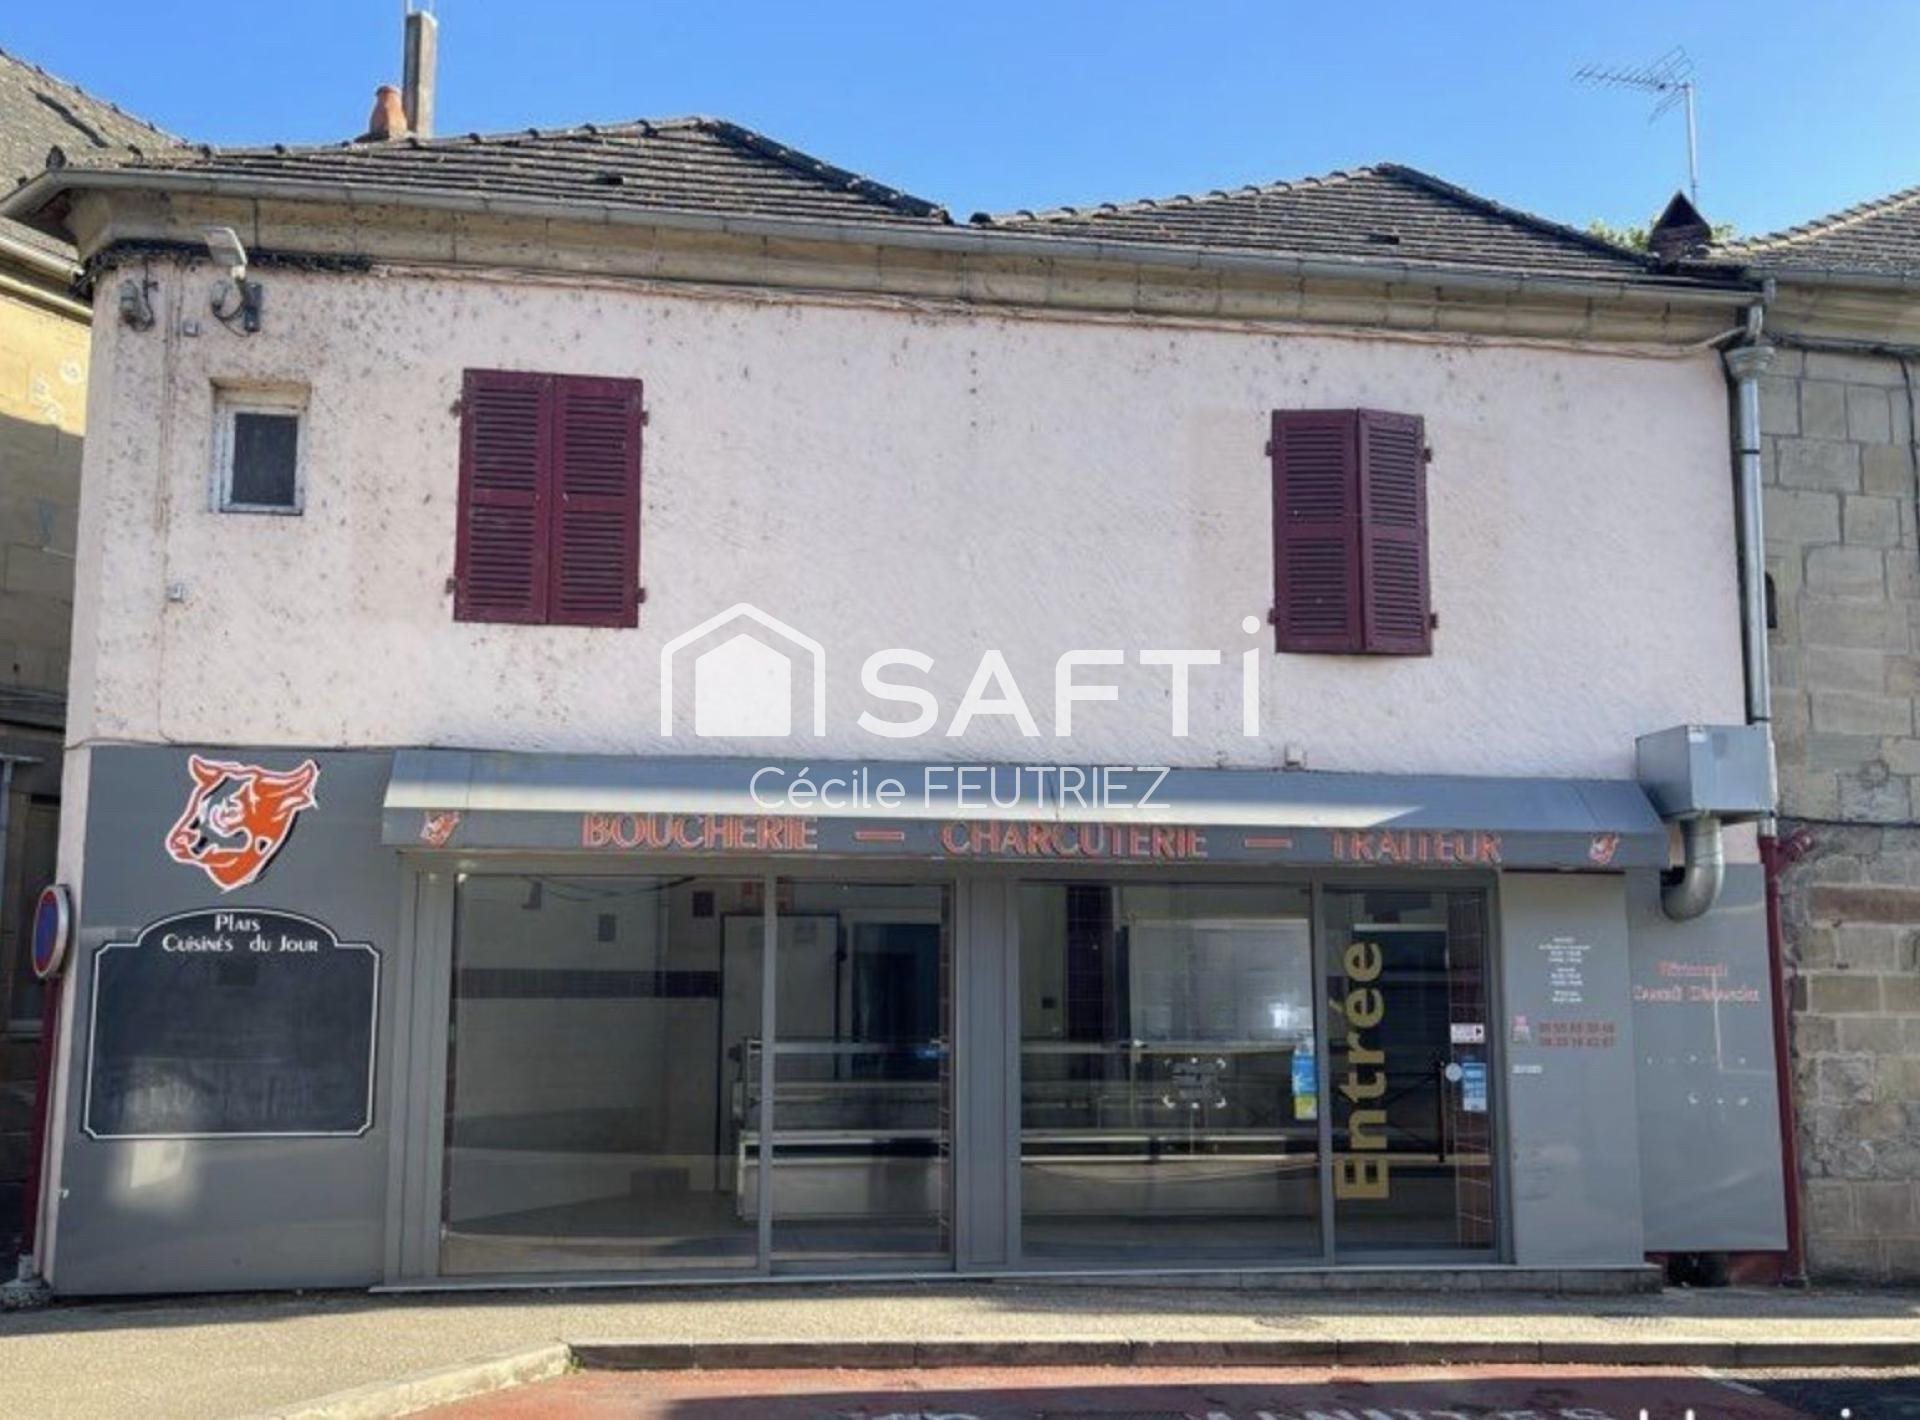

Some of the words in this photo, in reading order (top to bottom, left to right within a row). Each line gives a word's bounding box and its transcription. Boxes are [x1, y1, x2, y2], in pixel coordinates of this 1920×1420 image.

[582, 813, 818, 850] BOUCHERIE
[940, 820, 1208, 859] CHARCUTERIE
[1331, 829, 1502, 867] TRAITEUR
[249, 934, 272, 952] du
[1329, 942, 1390, 1199] Entrée
